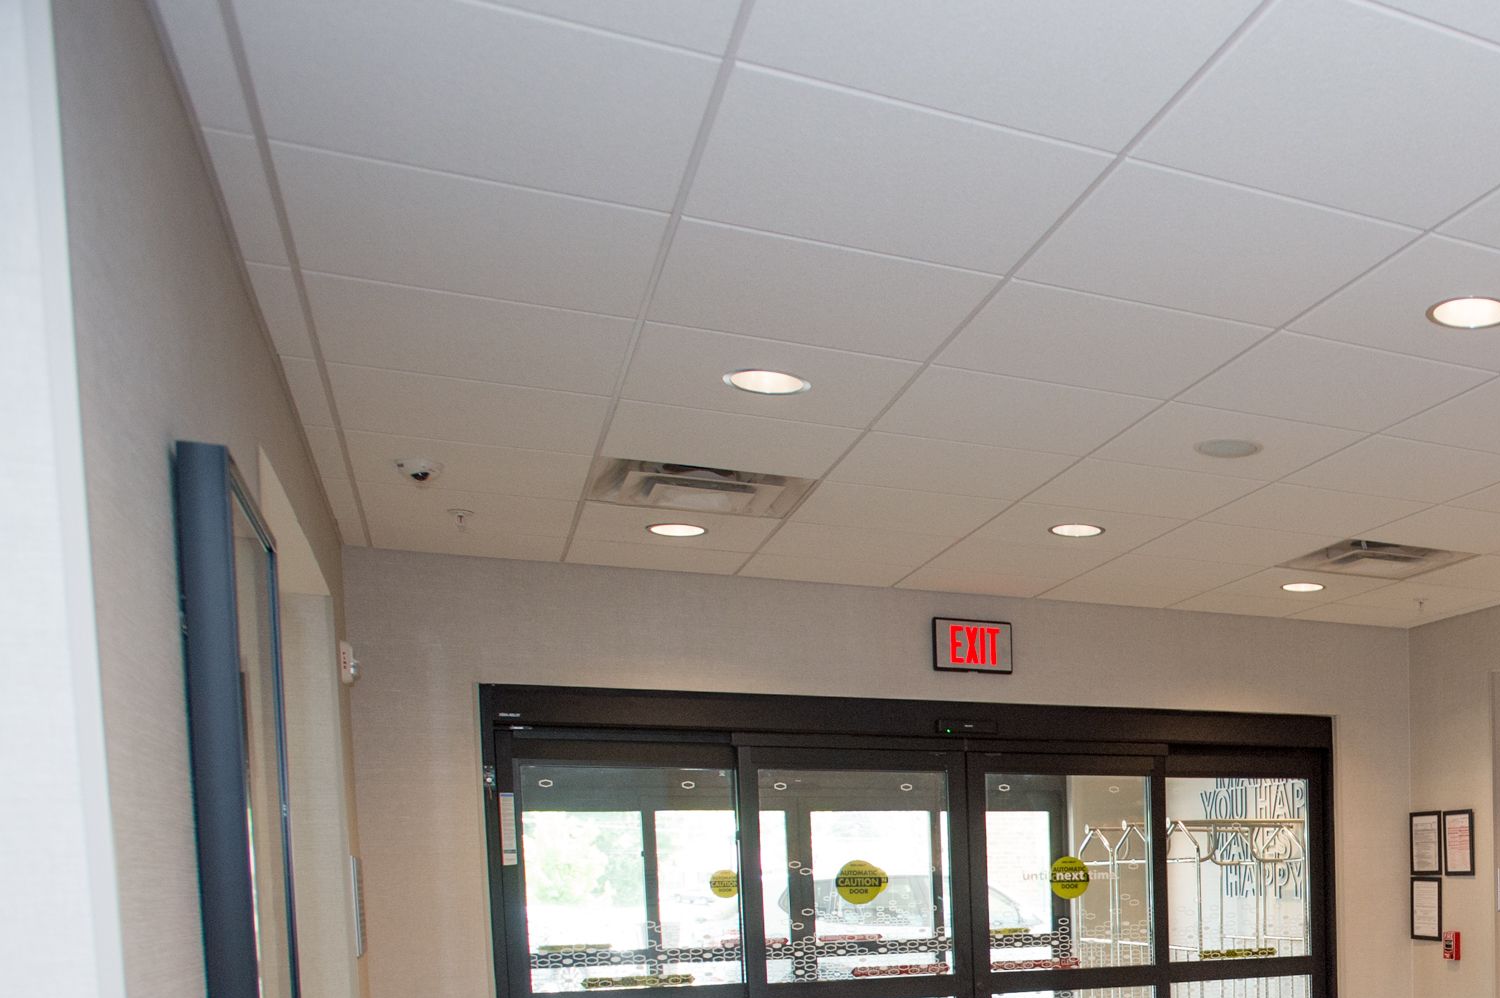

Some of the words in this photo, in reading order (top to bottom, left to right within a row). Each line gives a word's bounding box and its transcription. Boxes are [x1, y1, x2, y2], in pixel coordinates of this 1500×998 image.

[949, 624, 1001, 666] EXIT
[1200, 787, 1247, 819] YOU
[838, 878, 879, 886] CAUTION
[1056, 870, 1085, 881] next
